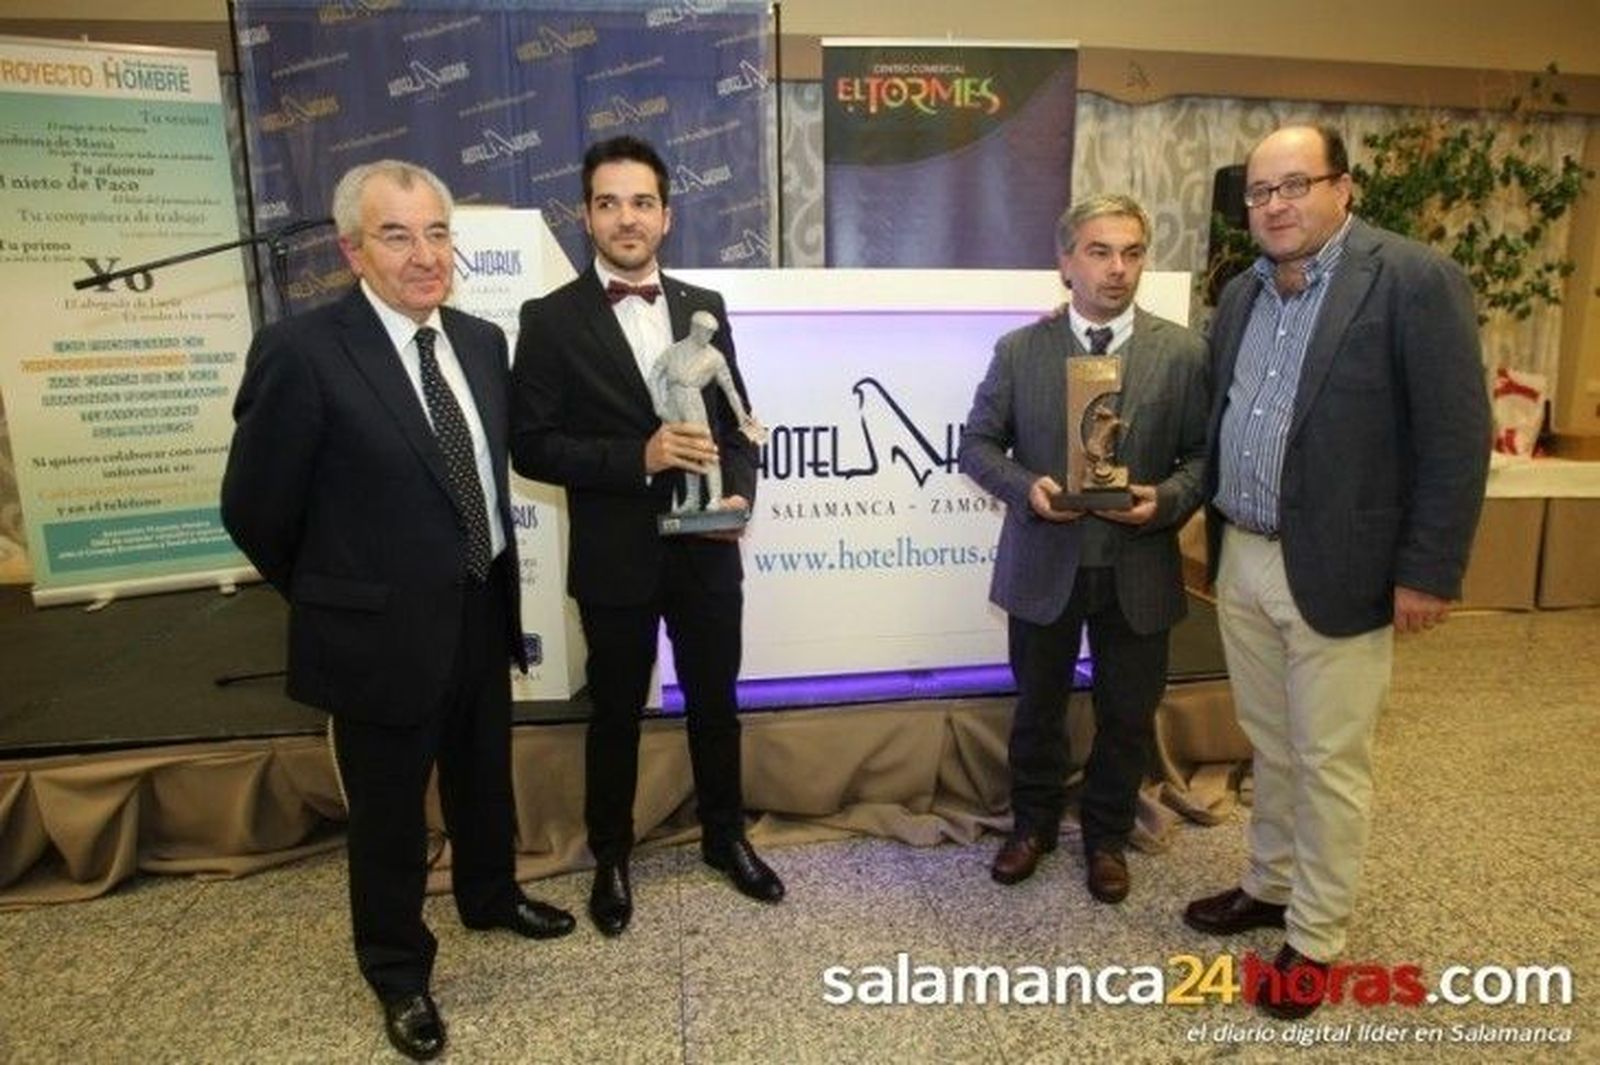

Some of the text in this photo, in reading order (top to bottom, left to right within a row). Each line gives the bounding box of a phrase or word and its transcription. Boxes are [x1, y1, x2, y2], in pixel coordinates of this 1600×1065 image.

[103, 62, 191, 93] HOMBRE
[873, 64, 965, 74] CENTRO COMERCIAL
[836, 77, 1001, 115] EL TORMES
[79, 256, 155, 293] Yo
[772, 500, 896, 519] SALAMANCA
[930, 497, 1000, 514] ZAMOR
[755, 537, 998, 572] www.hotelhorus.c
